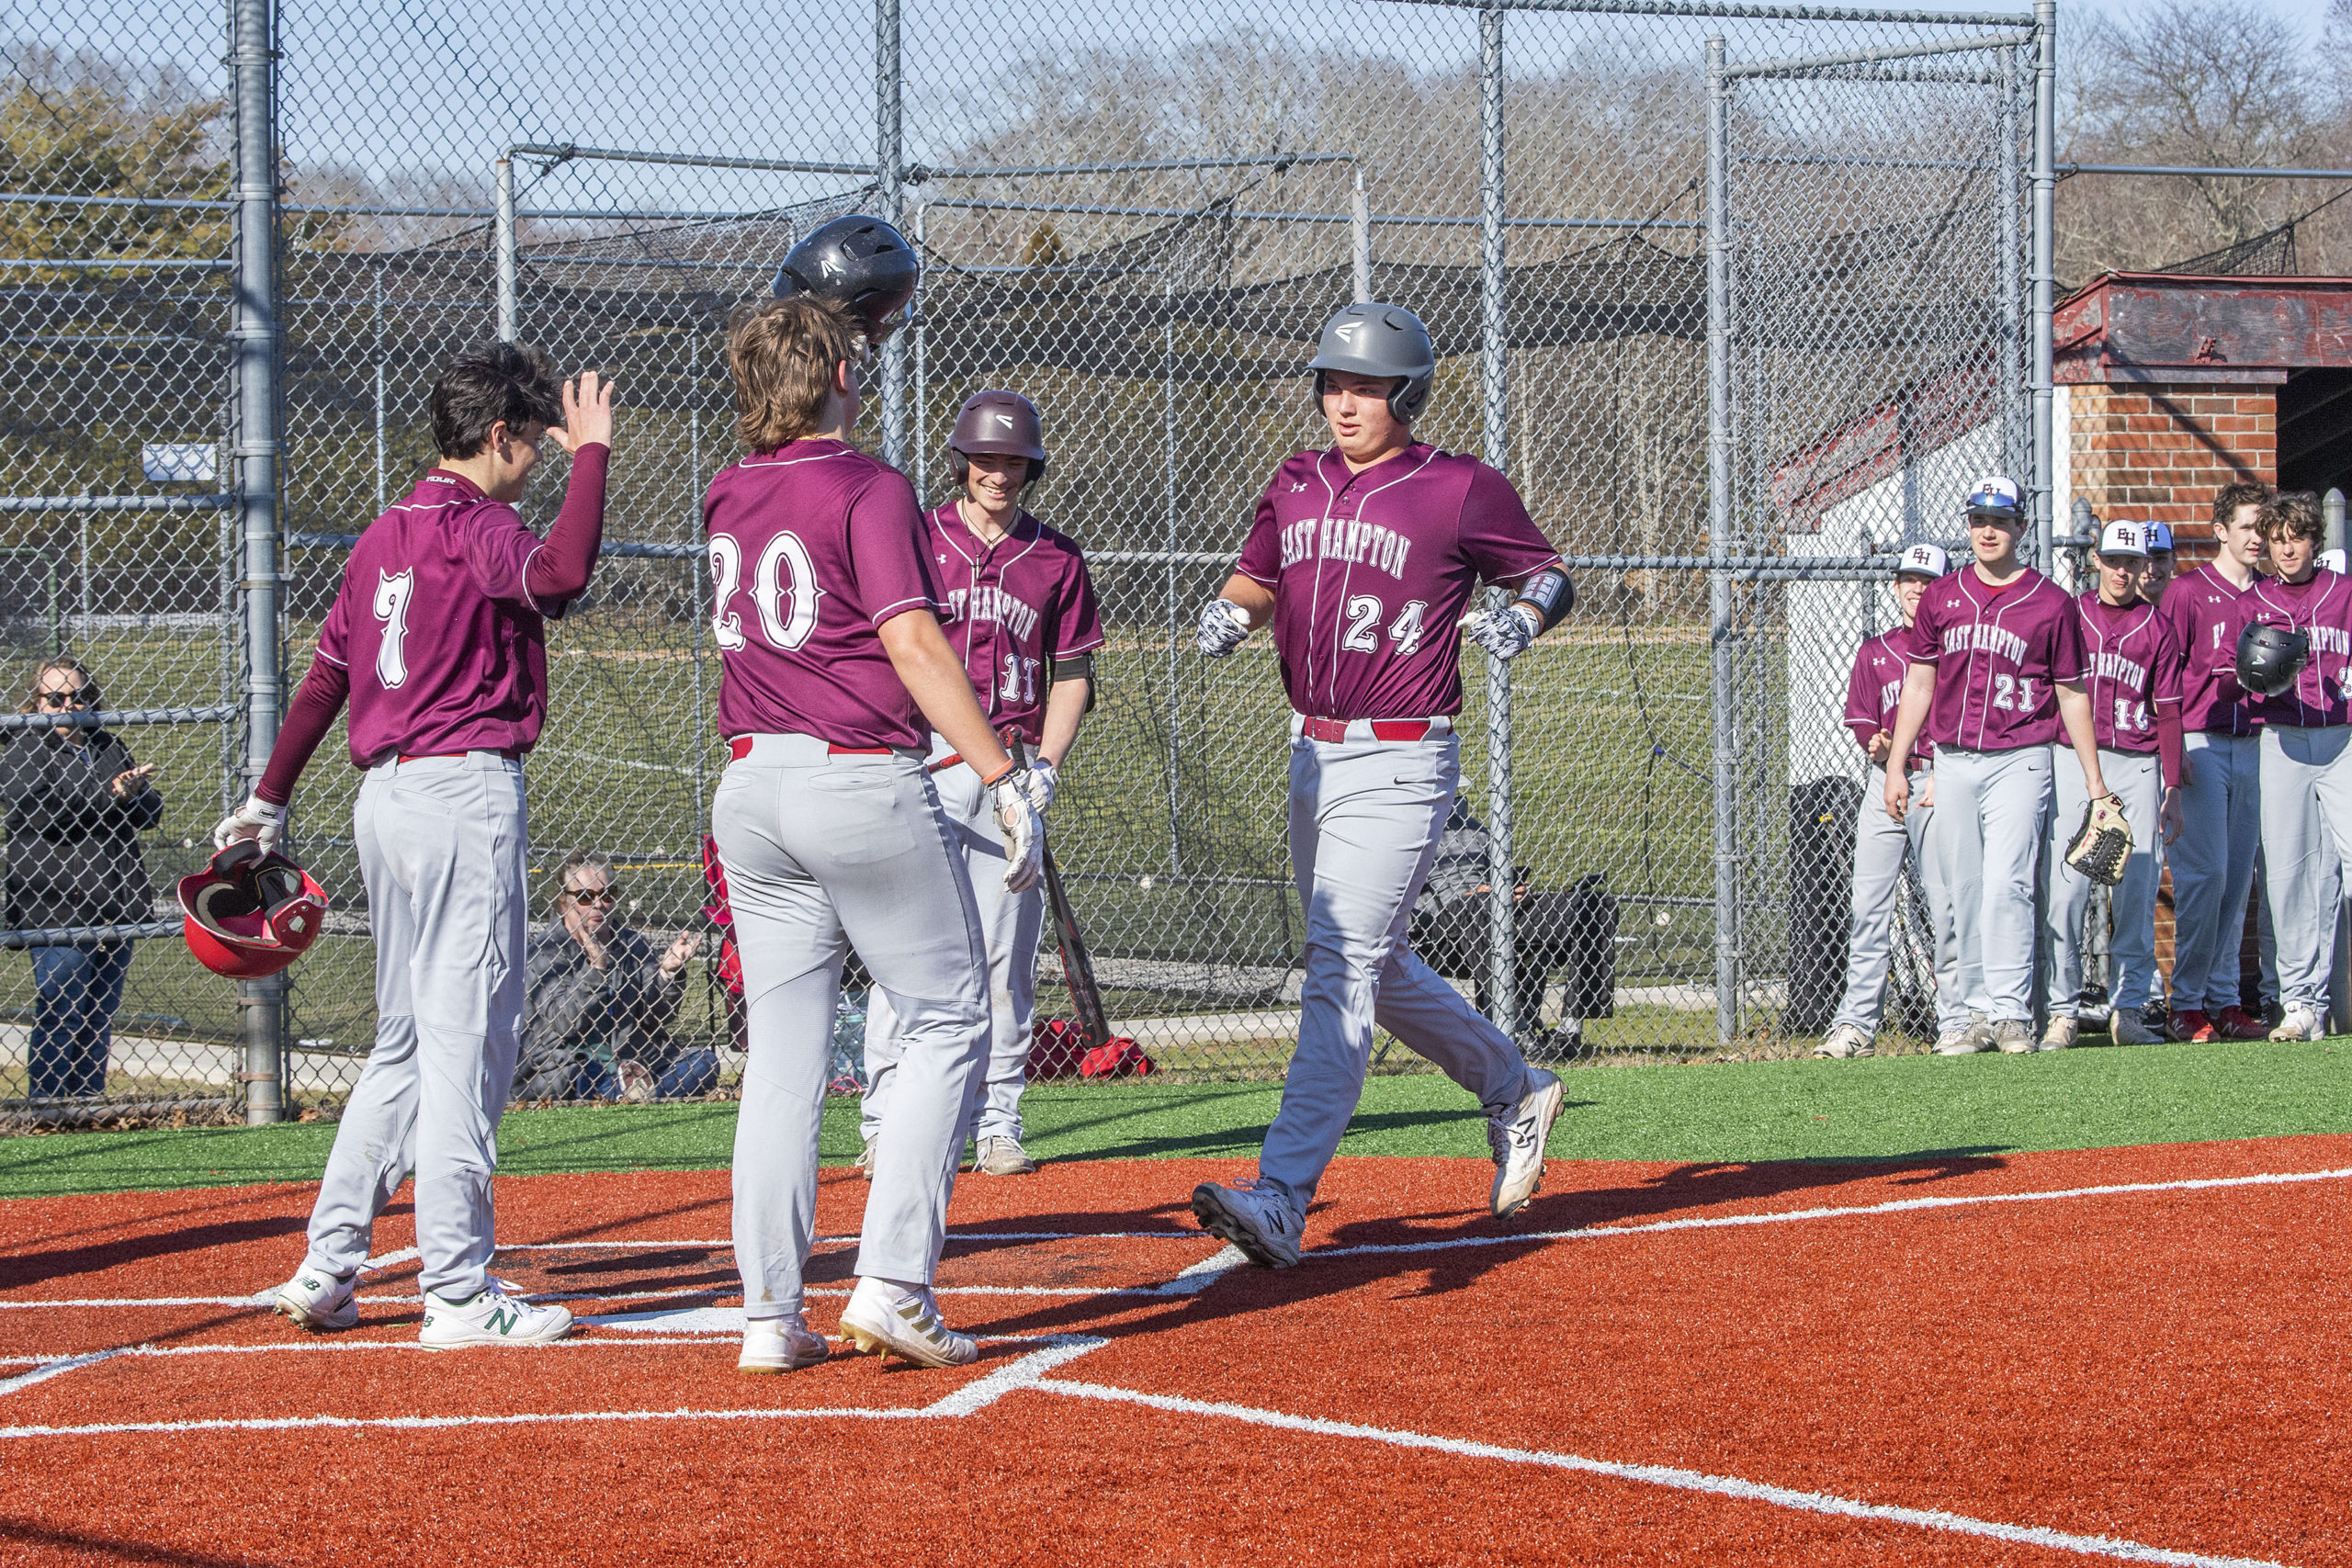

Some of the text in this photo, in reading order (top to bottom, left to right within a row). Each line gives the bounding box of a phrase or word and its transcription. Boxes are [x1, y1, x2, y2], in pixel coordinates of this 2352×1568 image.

[1320, 519, 1411, 580] HAMPTON
[1913, 547, 1931, 565] EH
[2117, 527, 2135, 547] EH
[708, 530, 827, 652] 20
[1341, 594, 1429, 656] 24
[2304, 626, 2350, 657] MPTON
[1944, 624, 2028, 667] EAST HAMPTON
[999, 653, 1040, 705] 11
[1882, 680, 1901, 715] AST
[1993, 672, 2035, 712] 21
[483, 1307, 519, 1336] N
